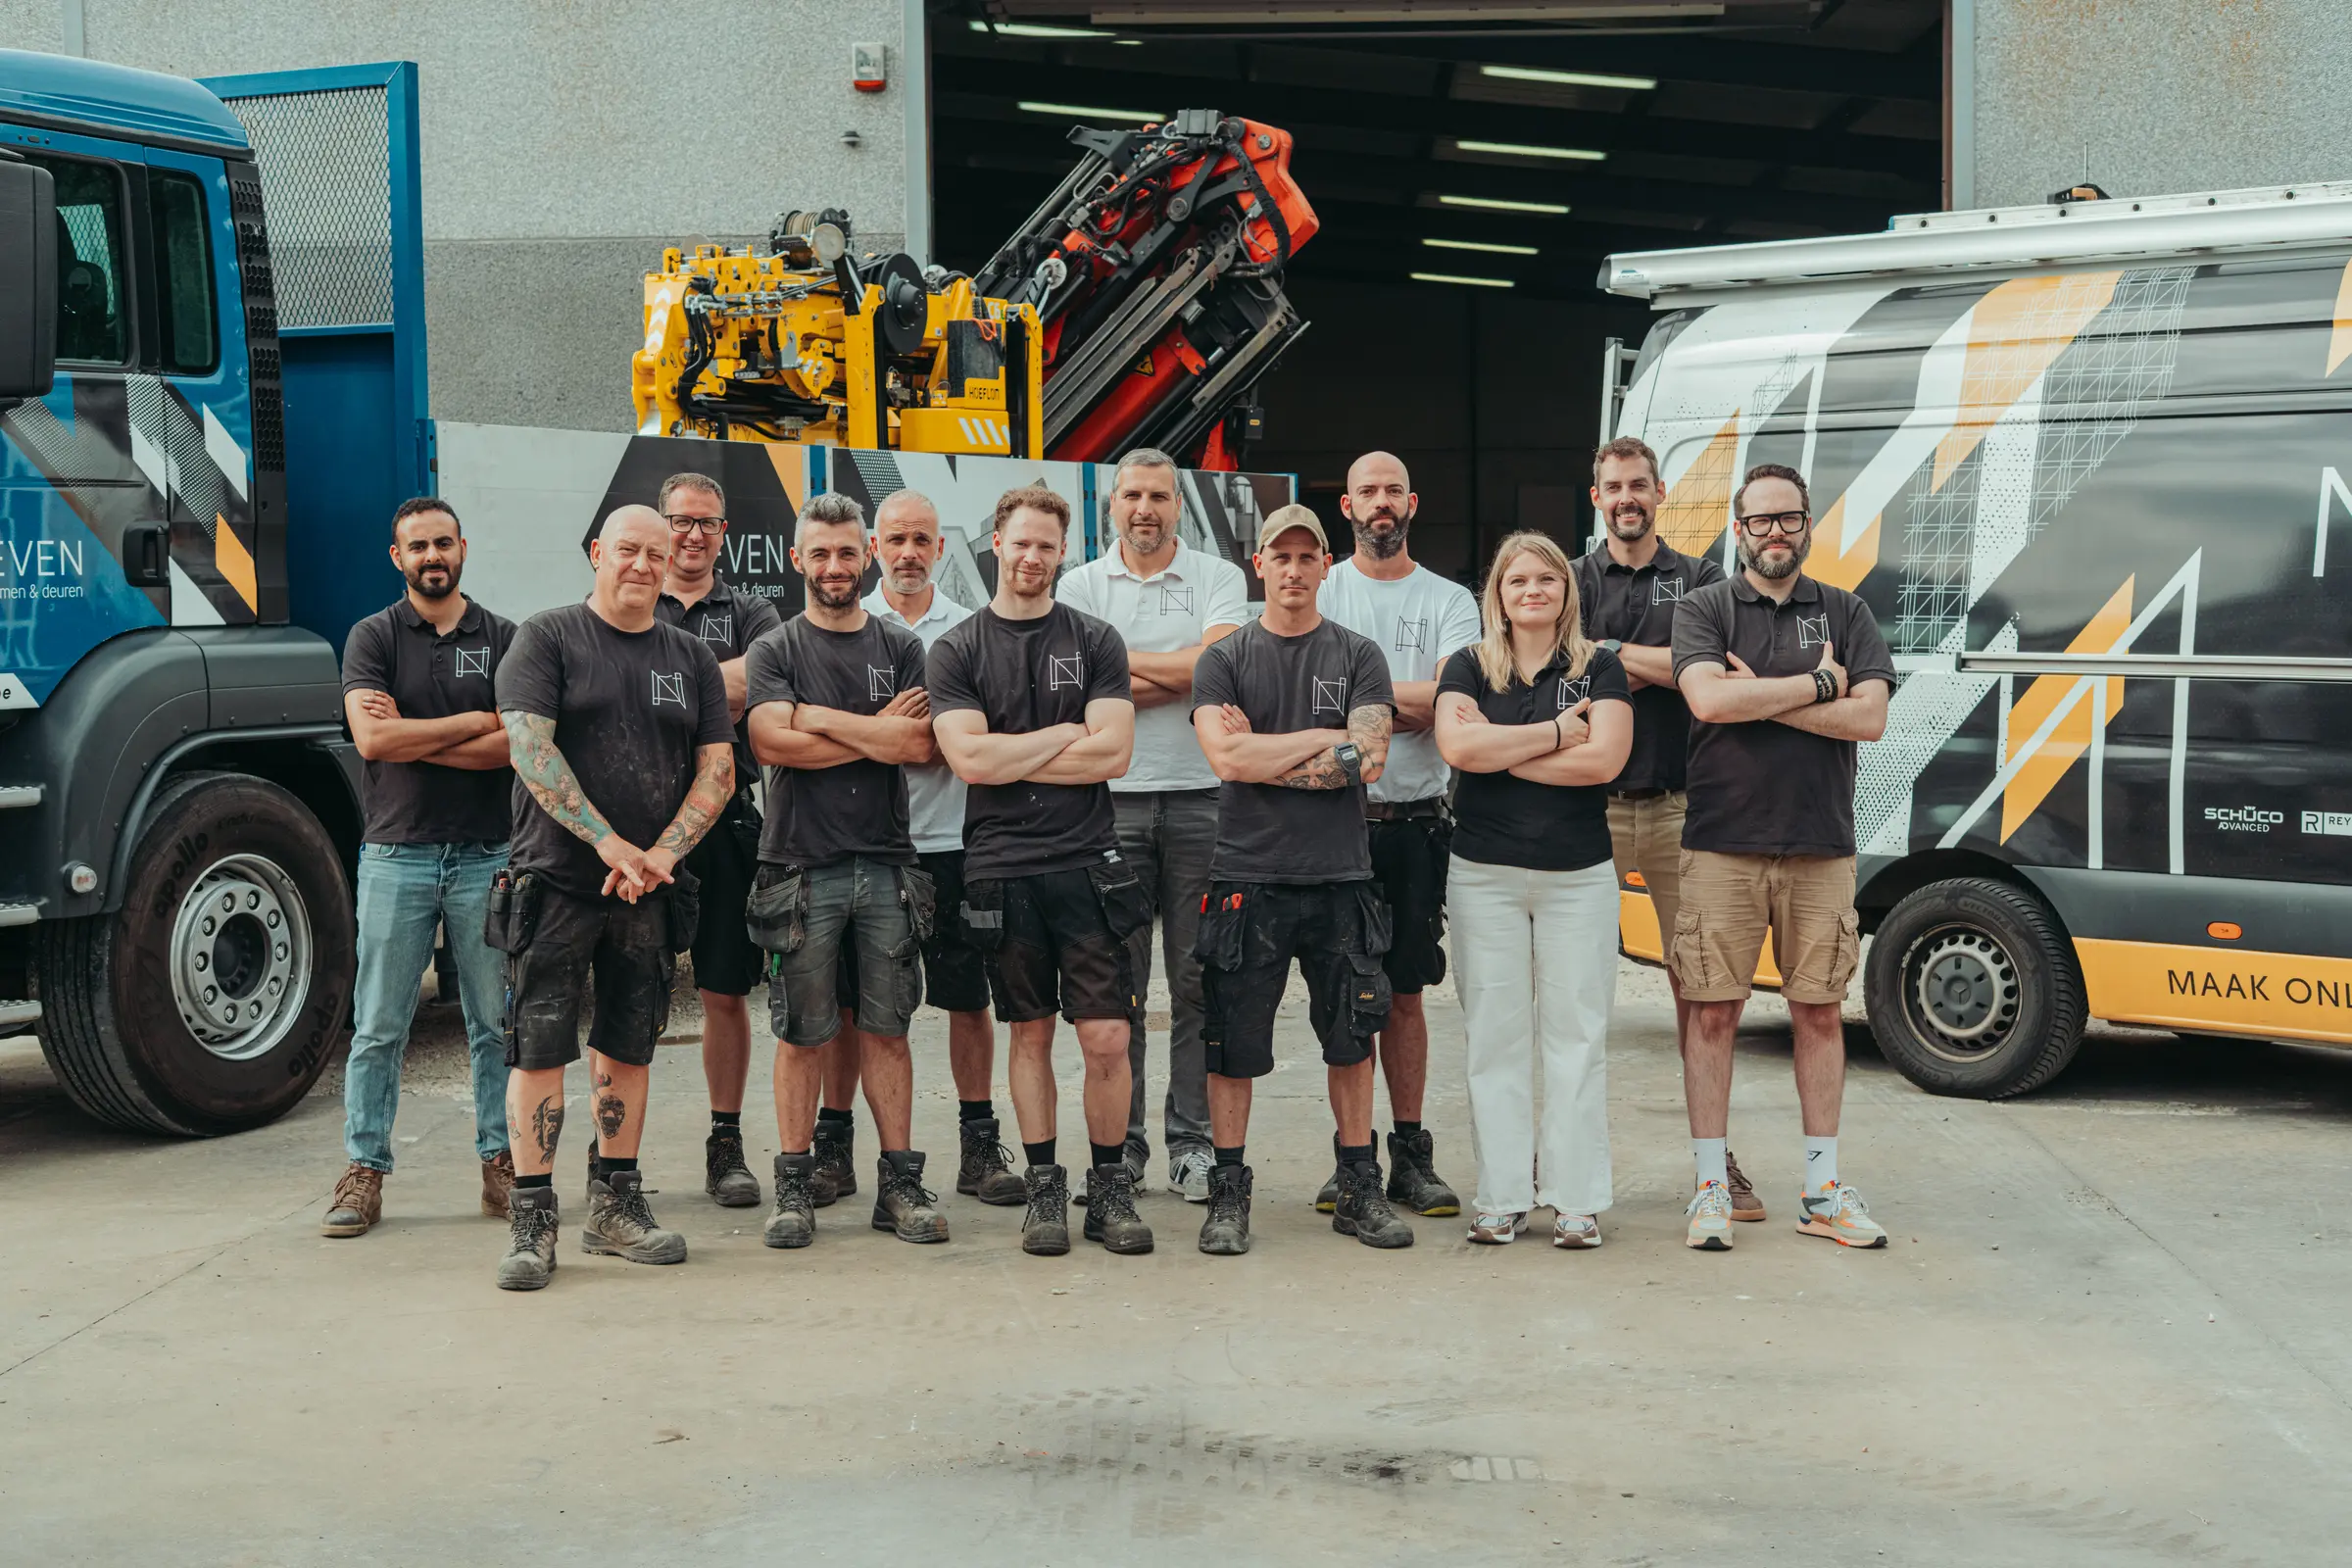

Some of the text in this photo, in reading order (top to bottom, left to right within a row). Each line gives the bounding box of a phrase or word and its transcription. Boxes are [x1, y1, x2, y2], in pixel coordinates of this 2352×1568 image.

[0, 540, 83, 576] VEN
[718, 533, 784, 574] VEN
[28, 583, 39, 599] &
[41, 583, 83, 599] deuren
[751, 582, 784, 598] deuren
[2204, 806, 2284, 824] SCHÜCO
[2218, 821, 2271, 833] ADVANCED
[154, 833, 209, 919] apollo
[2168, 969, 2270, 1001] MAAK
[287, 993, 339, 1078] apollo
